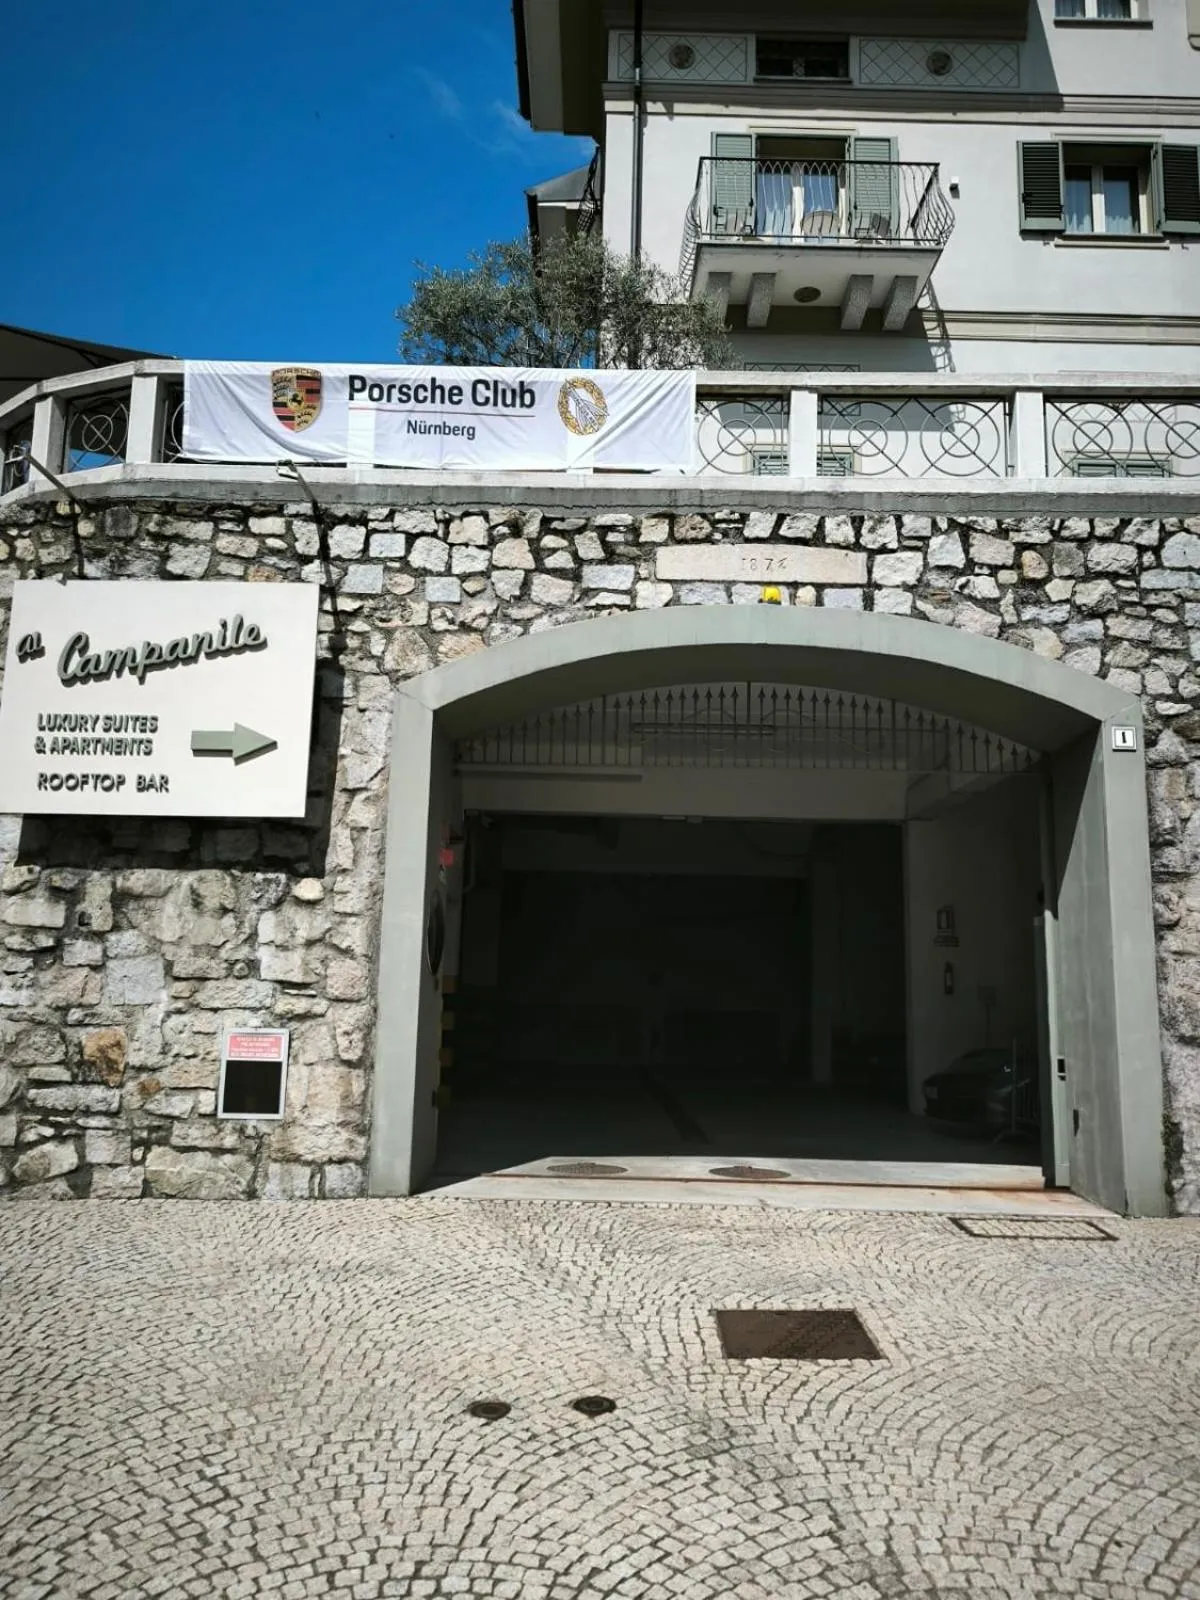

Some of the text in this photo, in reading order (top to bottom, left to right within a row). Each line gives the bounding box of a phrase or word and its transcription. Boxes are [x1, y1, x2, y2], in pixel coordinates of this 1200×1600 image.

[349, 375, 536, 409] Porsche Club
[406, 420, 476, 441] Nürnberg
[57, 613, 267, 685] Campanile
[38, 713, 159, 734] LUXURY SUITES
[34, 736, 153, 756] & APARTMENTS
[37, 772, 170, 793] ROOFTOP BAR
